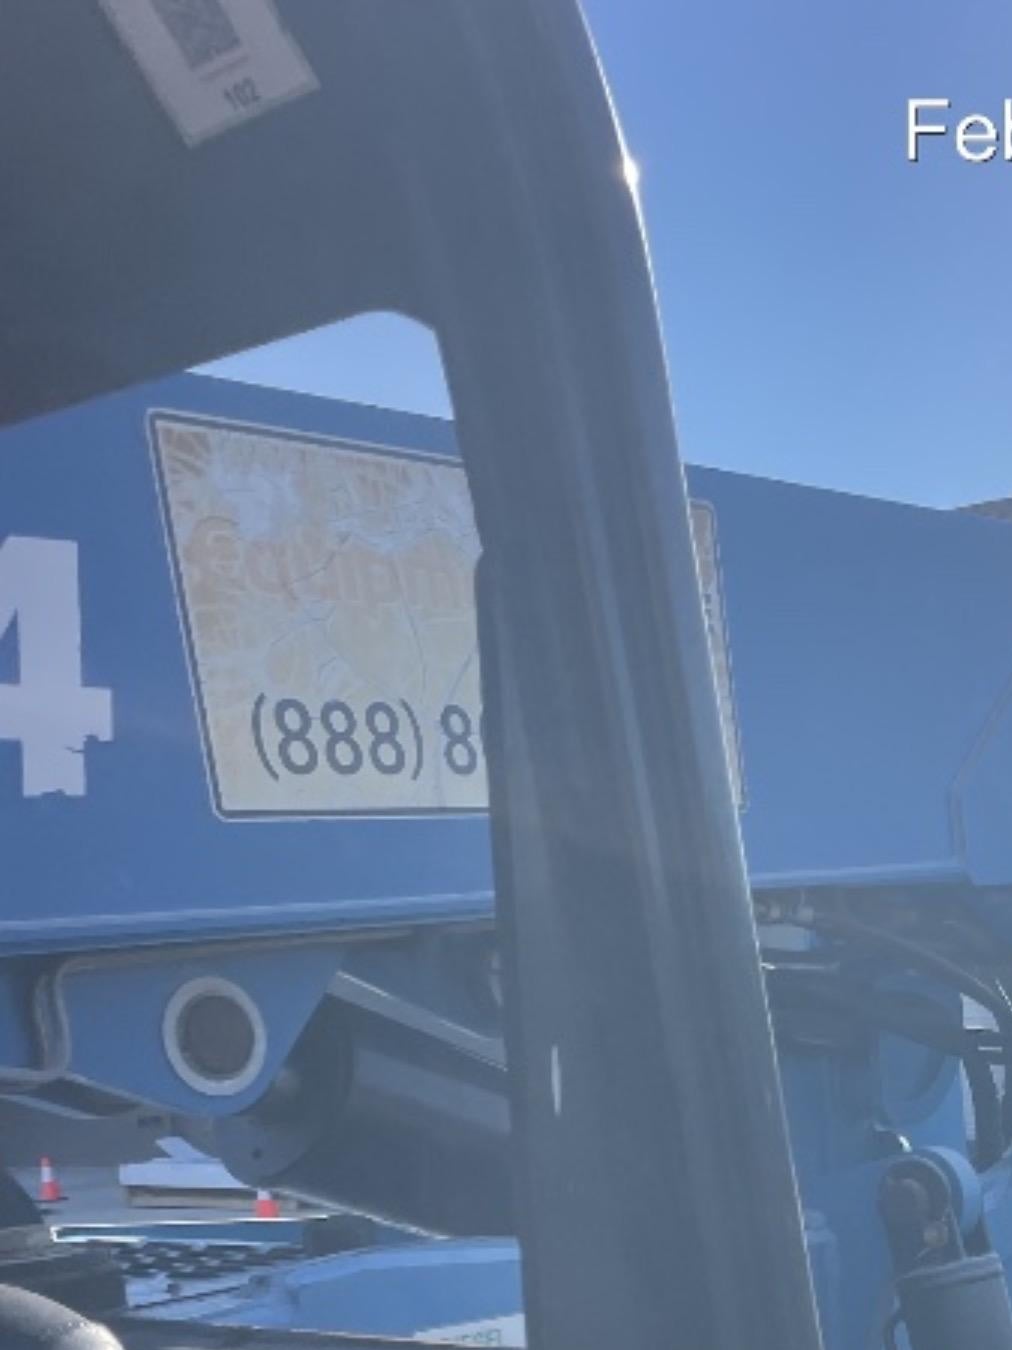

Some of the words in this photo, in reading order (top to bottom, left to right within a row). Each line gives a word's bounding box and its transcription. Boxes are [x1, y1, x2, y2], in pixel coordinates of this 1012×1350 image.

[0, 535, 113, 796] 4
[252, 692, 423, 781] (888)
[440, 704, 484, 775] 8
